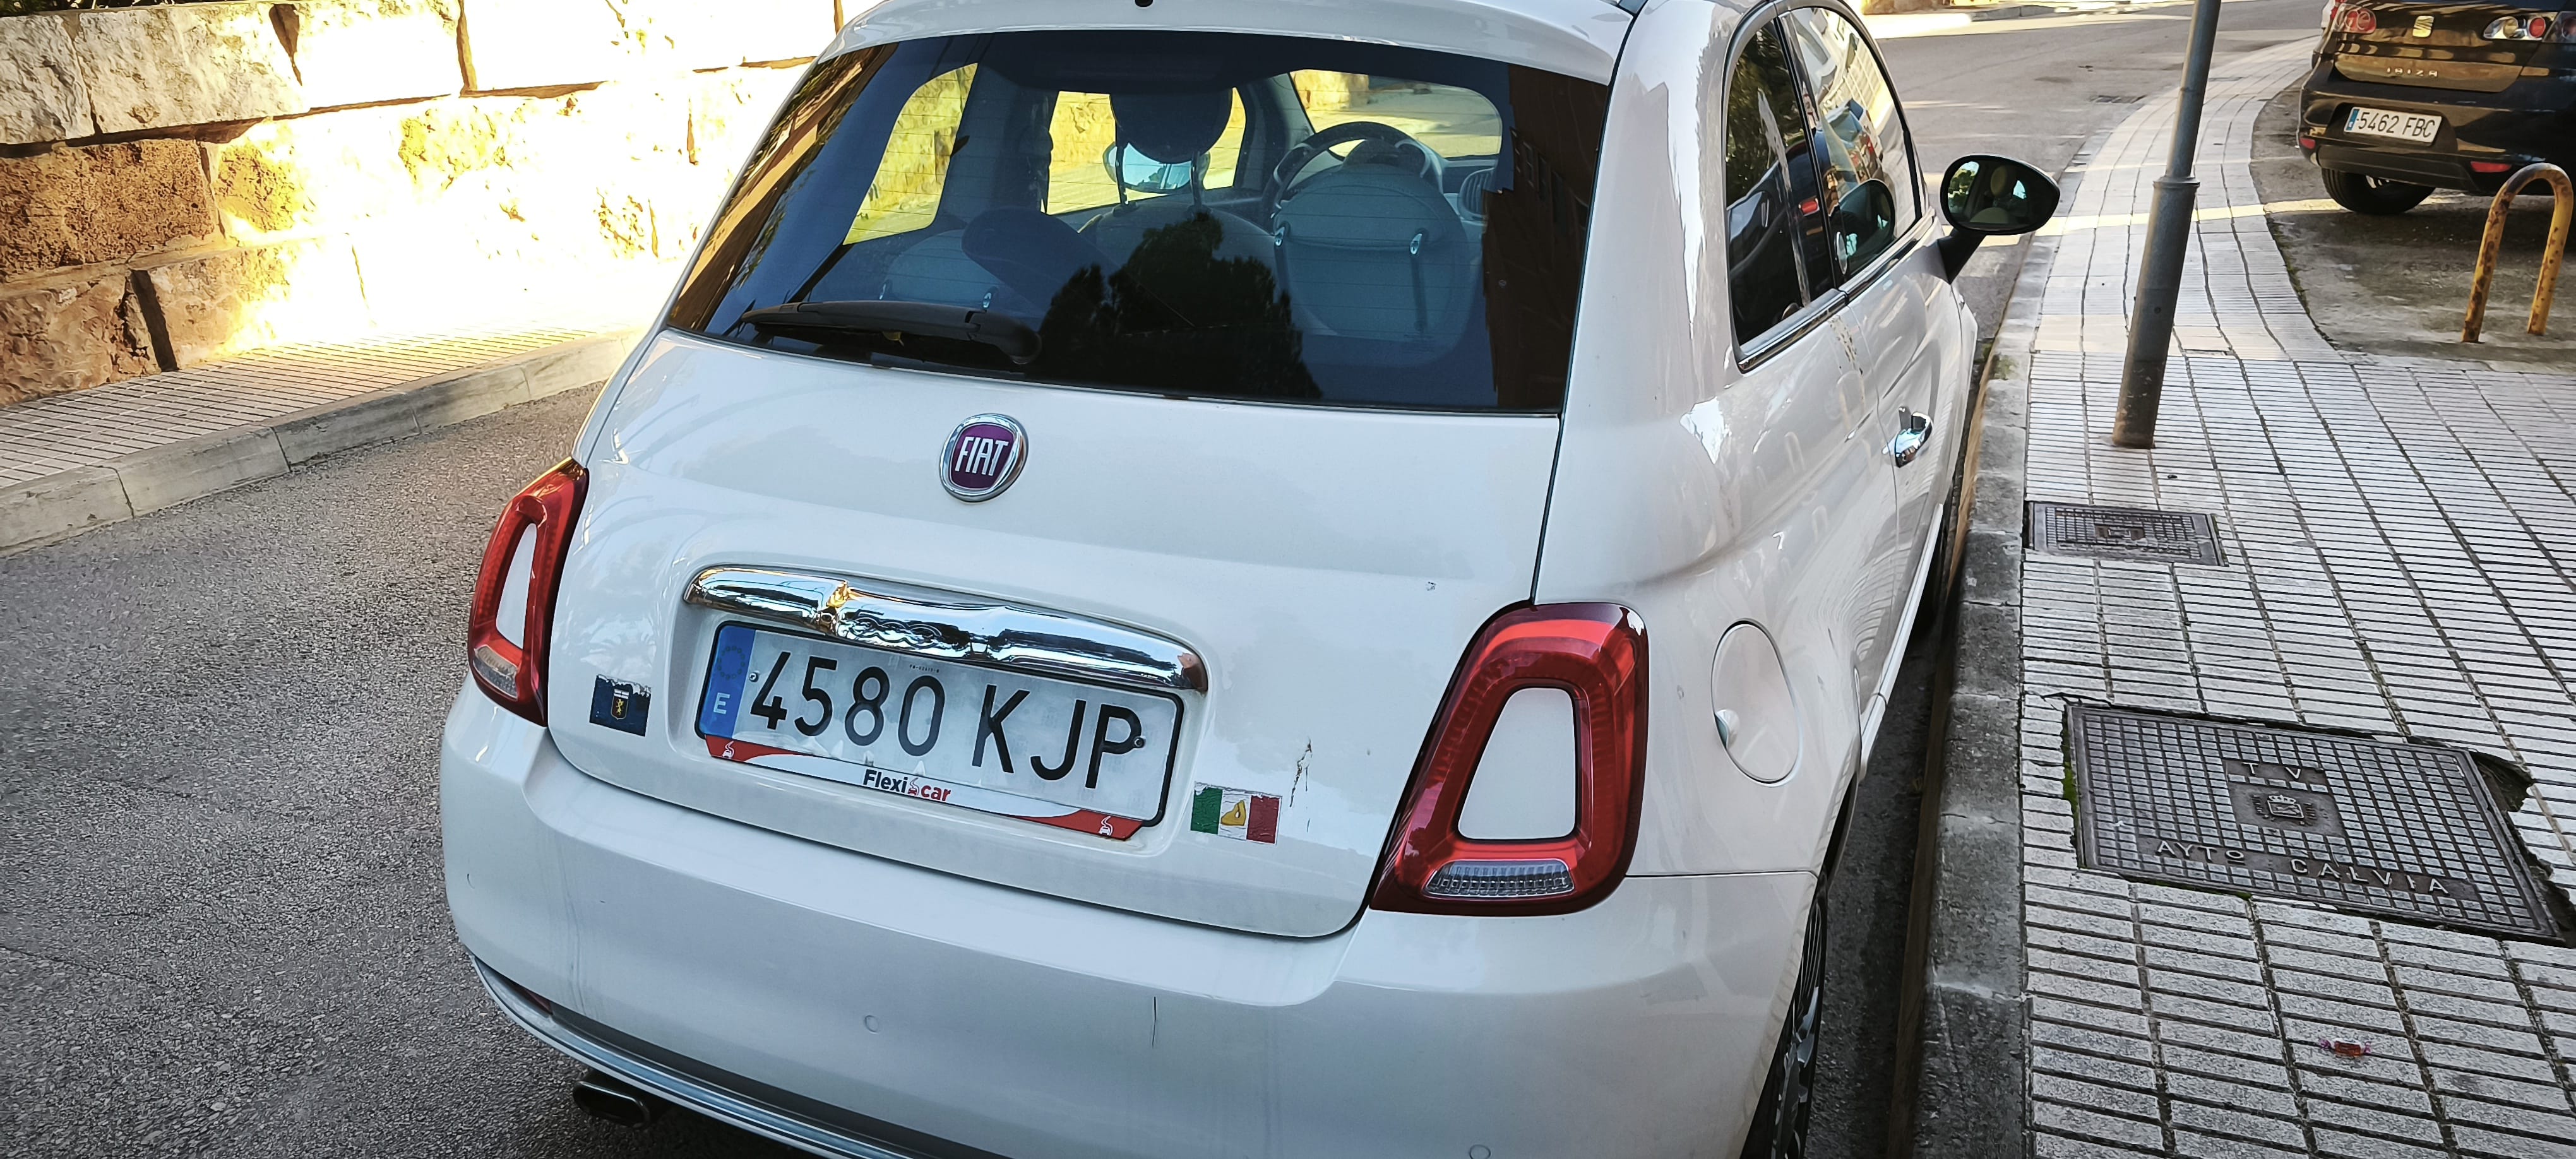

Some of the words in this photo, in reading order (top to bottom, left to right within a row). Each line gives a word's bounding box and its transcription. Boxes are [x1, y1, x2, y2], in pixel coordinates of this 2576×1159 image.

[2358, 112, 2399, 133] 5462
[2402, 117, 2435, 138] FBC
[955, 436, 1009, 476] FIAT
[713, 692, 730, 715] E
[750, 651, 945, 757] 4580
[972, 684, 1142, 789] KJP
[2290, 859, 2448, 895] CALVIA
